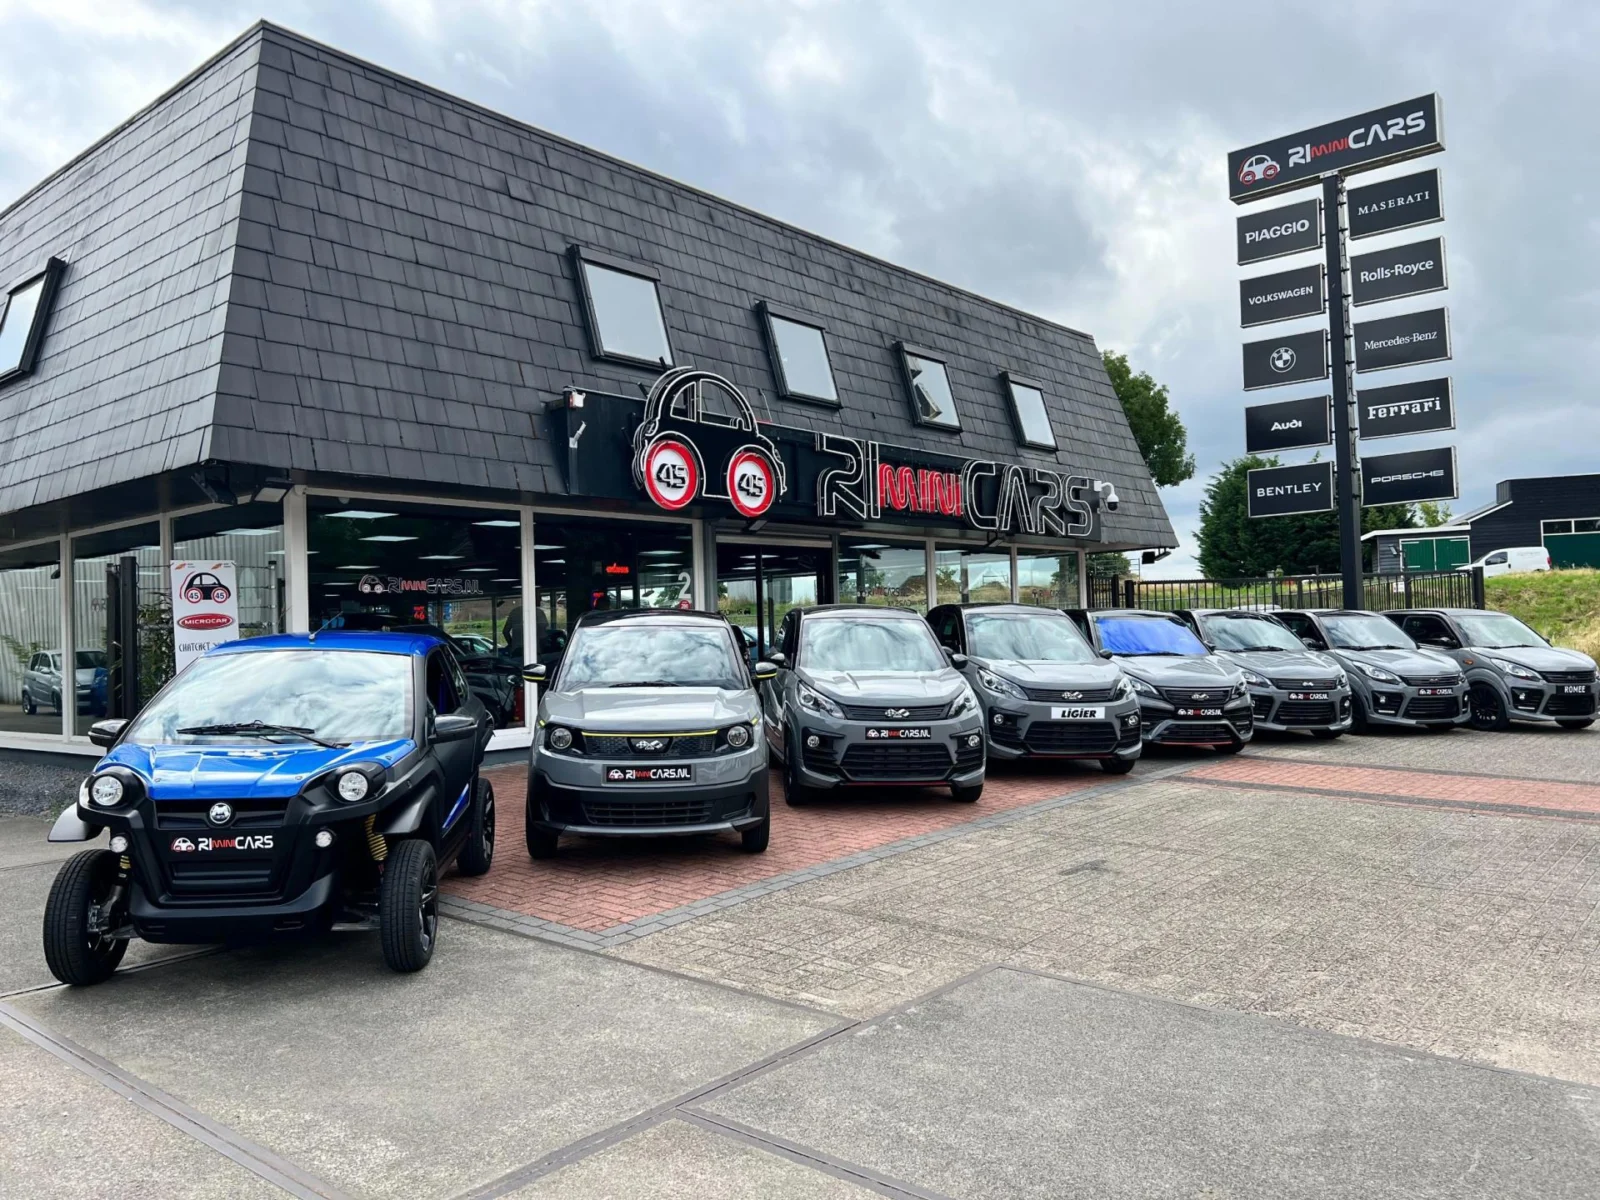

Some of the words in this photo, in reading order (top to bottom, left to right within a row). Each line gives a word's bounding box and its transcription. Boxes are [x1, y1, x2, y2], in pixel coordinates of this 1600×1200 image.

[1357, 190, 1431, 216] MASERATI
[1245, 218, 1310, 244] PIAGGIO
[1360, 259, 1434, 283] Rolls-Royce
[1248, 285, 1314, 306] VOLKSWAGEN
[1364, 329, 1438, 351] Mercedes-Benz
[1367, 397, 1441, 420] Ferrari
[1270, 420, 1303, 432] Audi
[656, 462, 689, 489] 45
[736, 472, 767, 498] 45
[1370, 469, 1445, 484] PORSCHE
[1256, 482, 1322, 497] BENTLEY
[189, 592, 200, 600] 45
[215, 592, 225, 600] 45
[678, 571, 692, 599] 2
[1564, 685, 1586, 693] ROMEE
